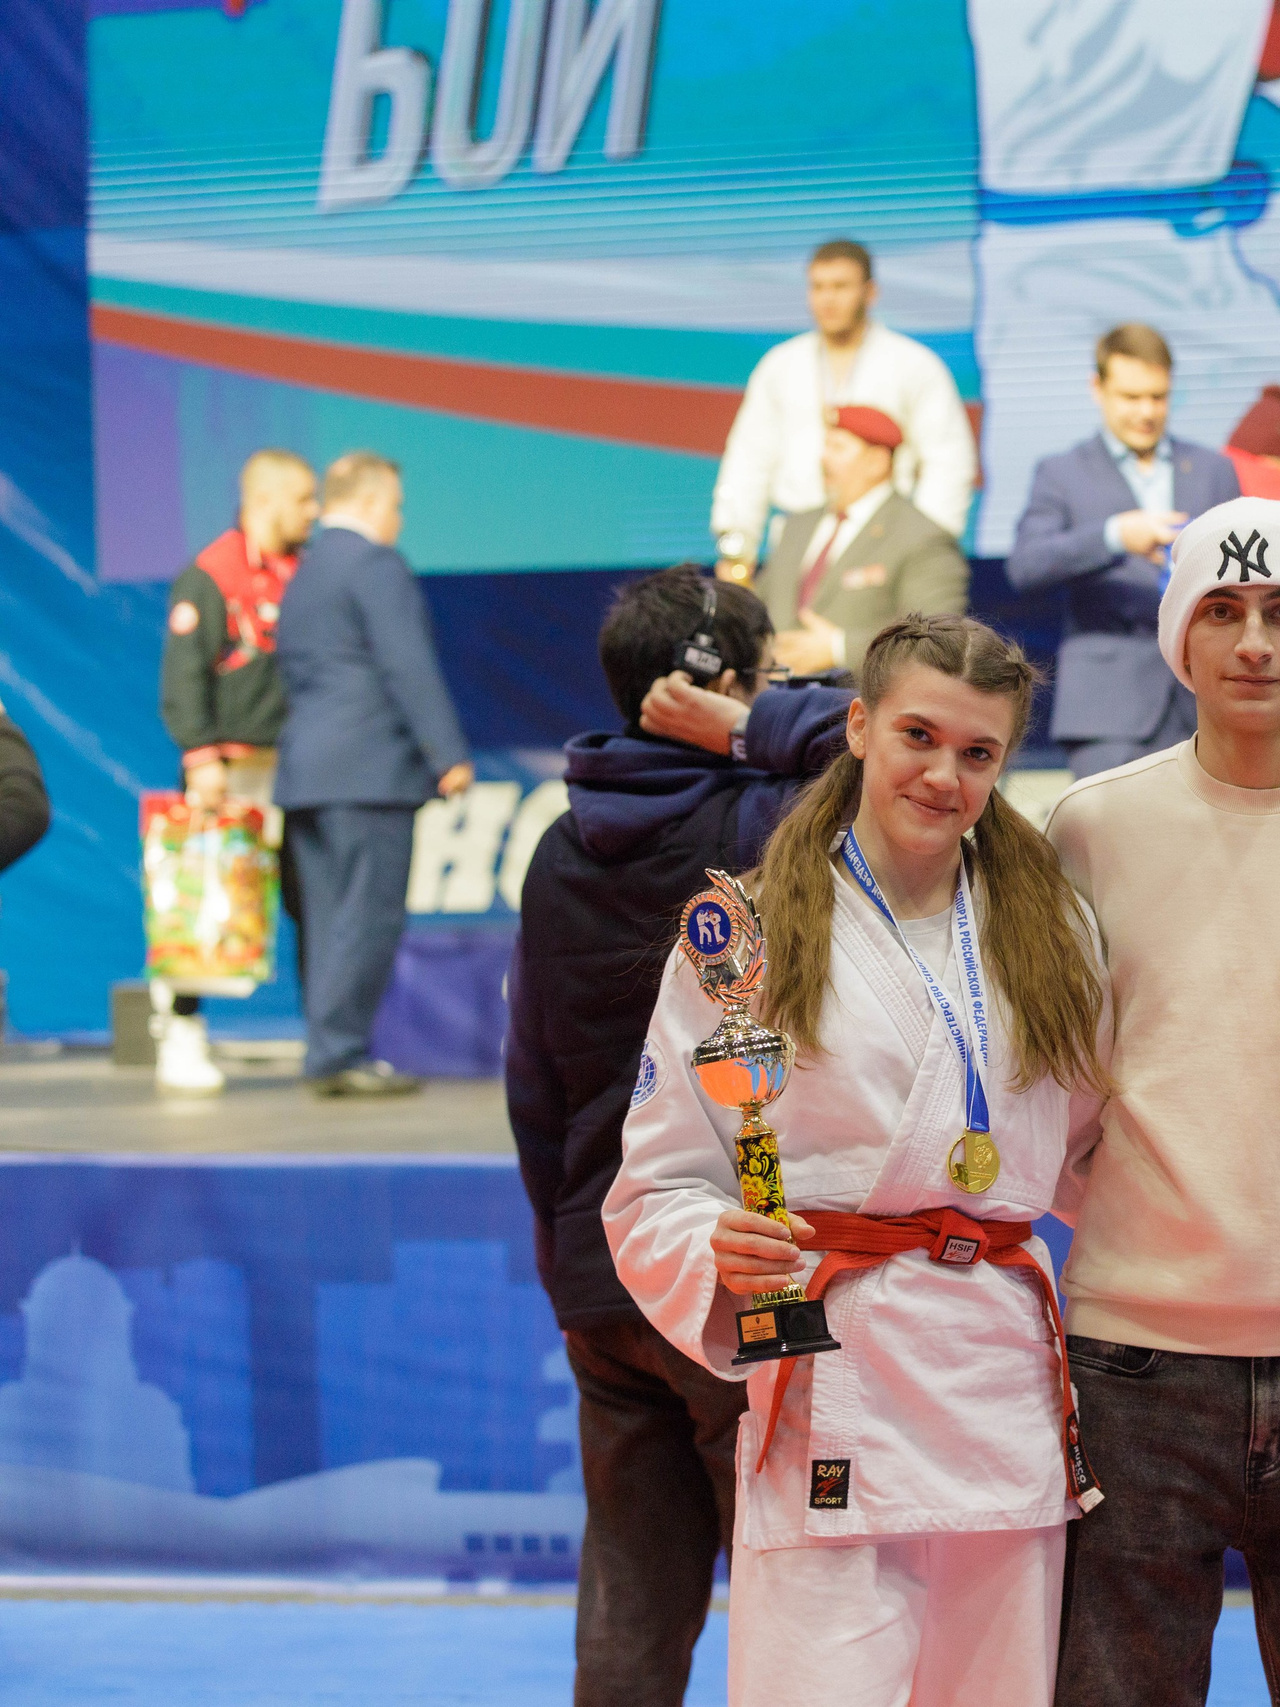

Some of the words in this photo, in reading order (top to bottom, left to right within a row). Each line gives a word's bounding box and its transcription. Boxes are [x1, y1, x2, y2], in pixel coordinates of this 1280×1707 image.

[960, 930, 984, 998] РОССИЙСКОЙ
[930, 985, 966, 1063] ИНИСТЕРСТВО
[949, 1242, 974, 1253] HSIF
[816, 1464, 846, 1478] RAY
[814, 1497, 842, 1505] SPORT
